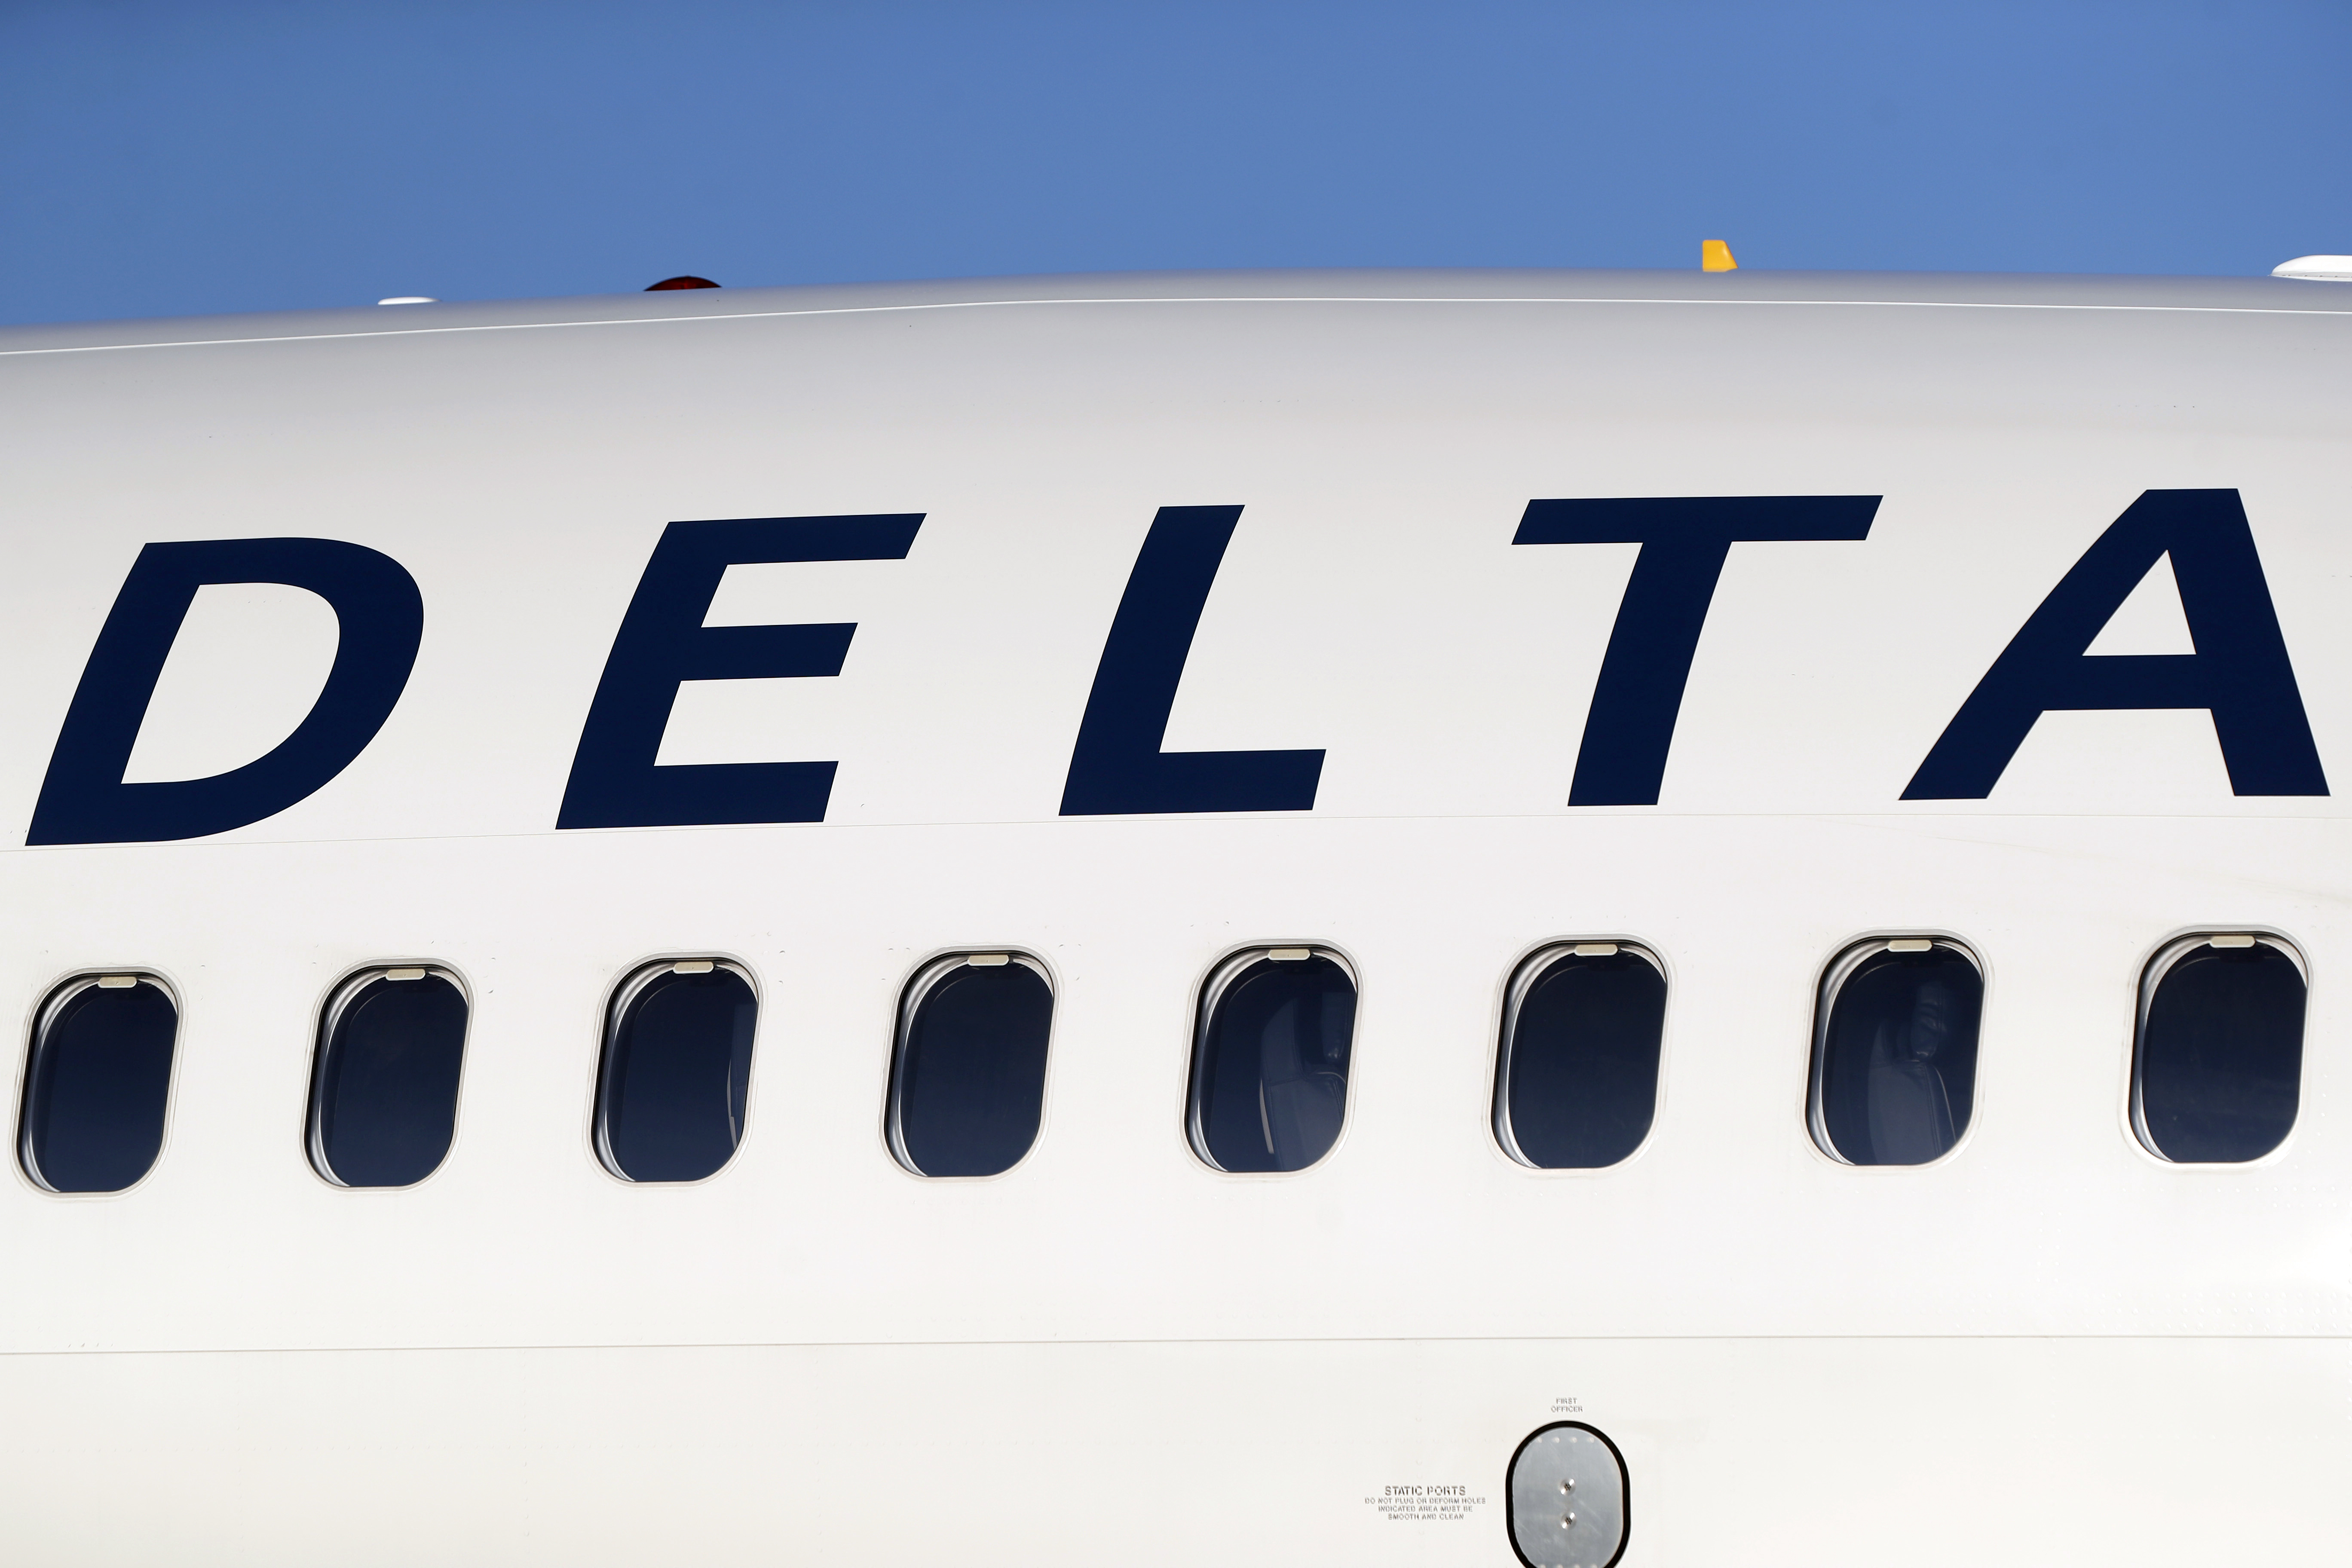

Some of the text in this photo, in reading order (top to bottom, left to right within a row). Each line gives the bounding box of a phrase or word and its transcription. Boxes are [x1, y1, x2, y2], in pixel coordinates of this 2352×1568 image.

[25, 488, 2331, 846] DELTA
[1385, 1485, 1466, 1496] STATIC PORTS
